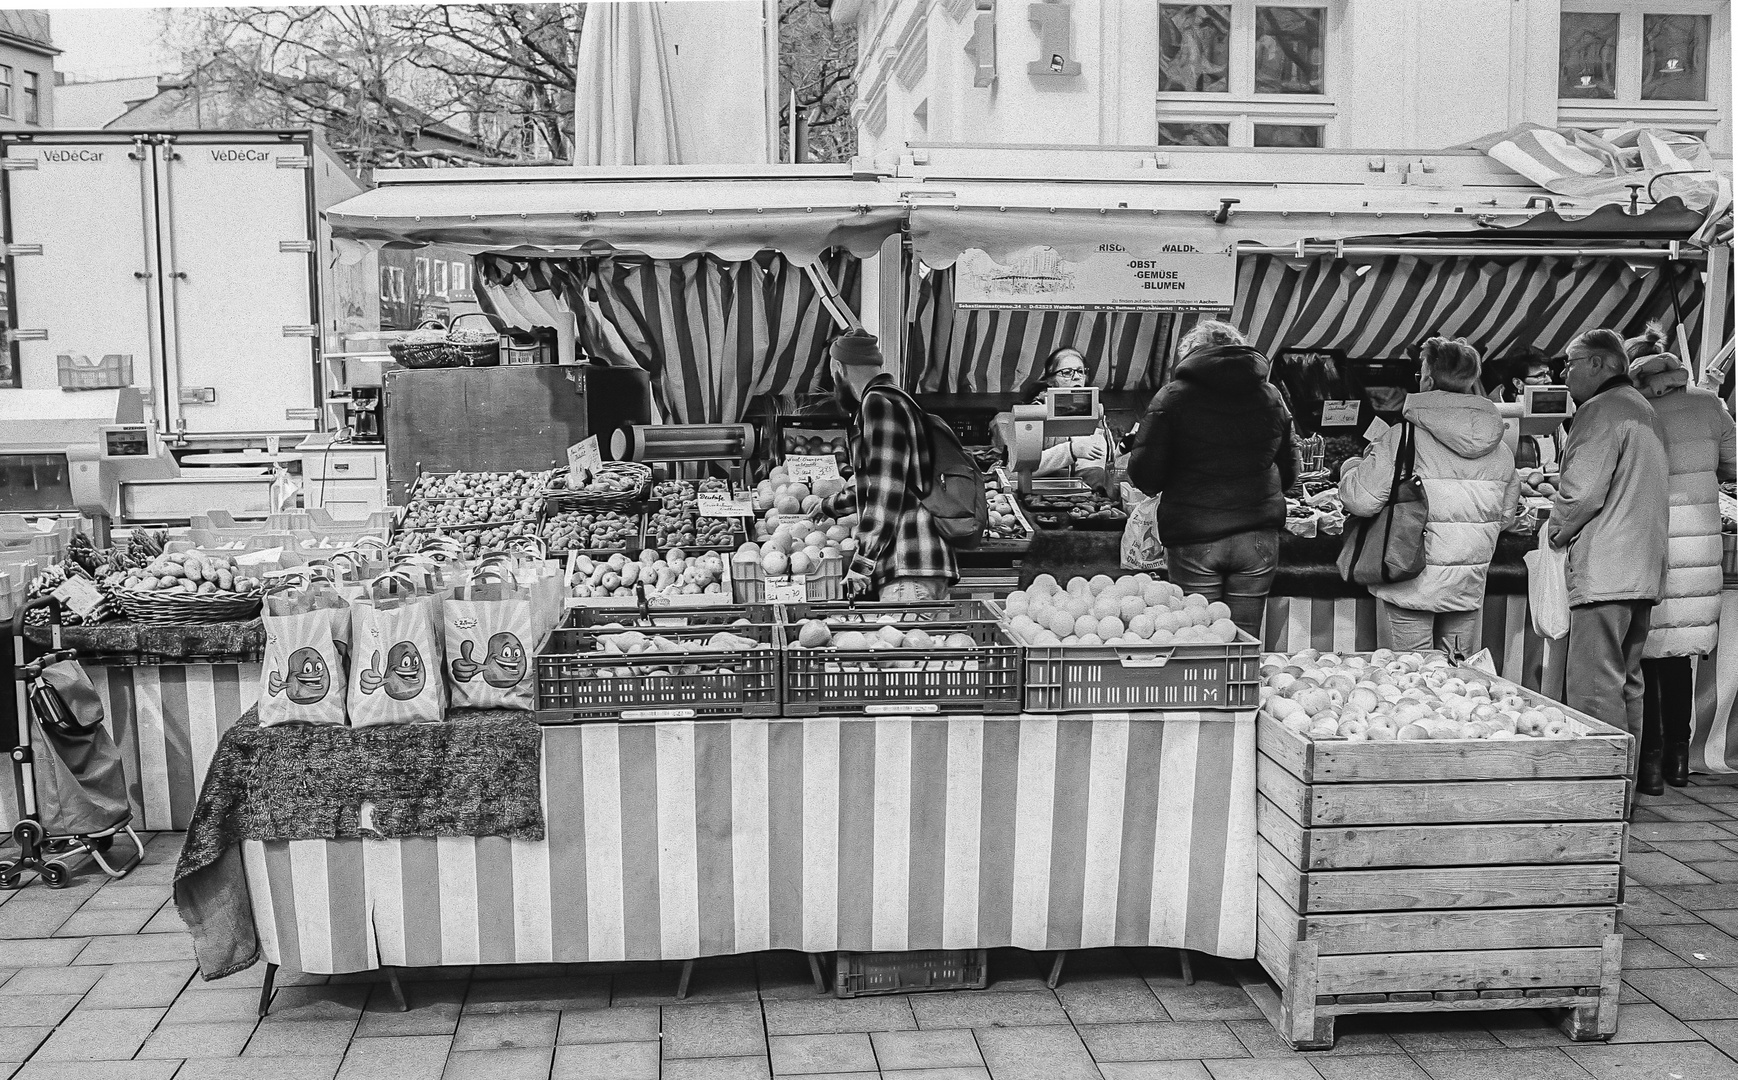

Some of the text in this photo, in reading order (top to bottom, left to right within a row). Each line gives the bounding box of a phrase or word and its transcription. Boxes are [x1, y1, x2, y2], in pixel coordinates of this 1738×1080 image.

[1096, 243, 1126, 252] RISC
[1133, 269, 1179, 279] -GEMÜSE
[1141, 281, 1186, 290] -BLUMEN
